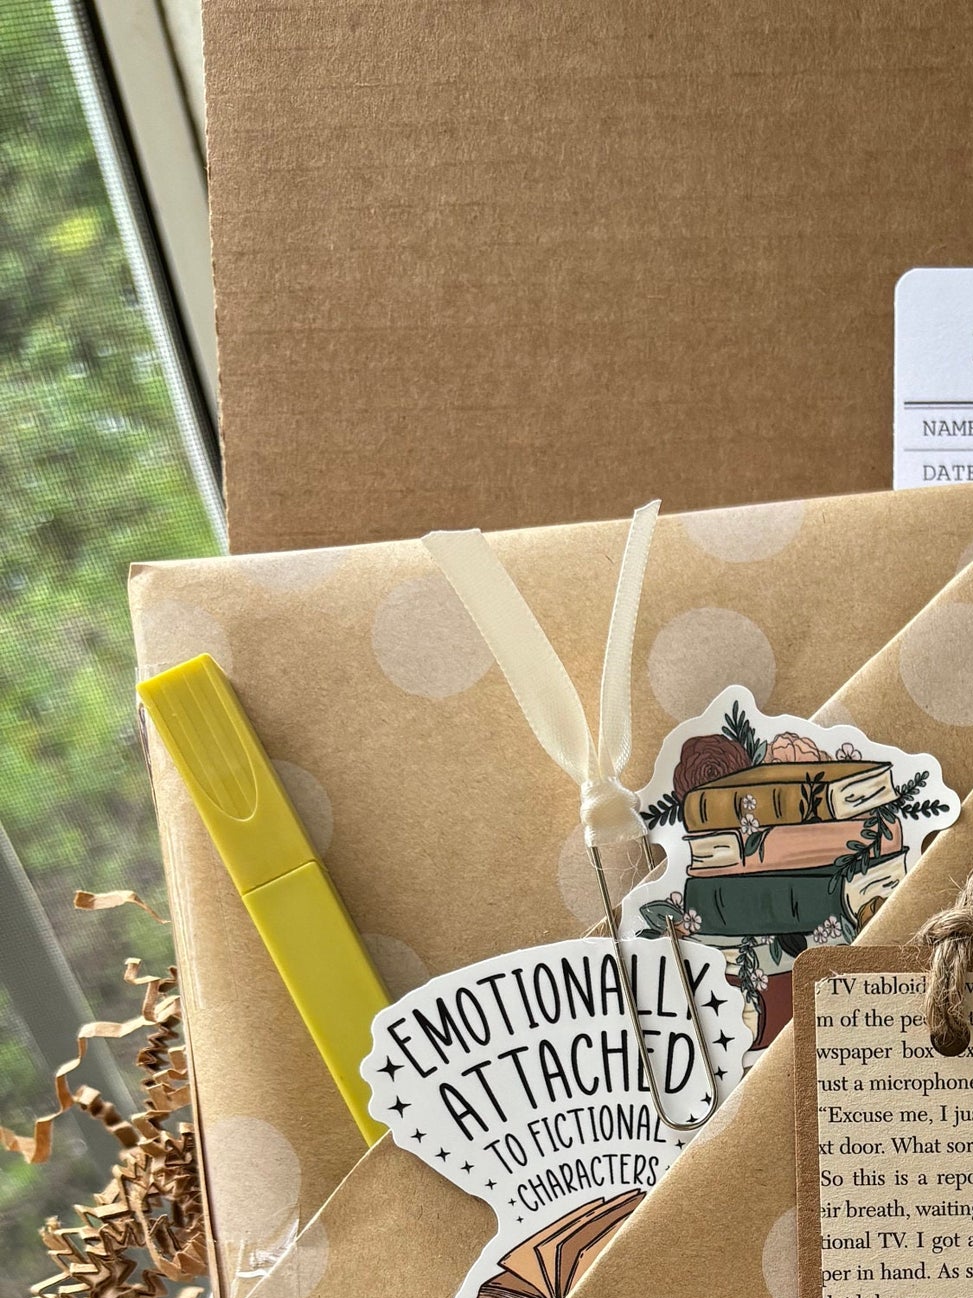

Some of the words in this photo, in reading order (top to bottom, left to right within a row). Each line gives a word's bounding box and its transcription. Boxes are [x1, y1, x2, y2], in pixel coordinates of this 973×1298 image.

[828, 977, 856, 995] TV
[387, 953, 710, 1079] EMOTIONALLY
[840, 1010, 860, 1028] of
[865, 1010, 894, 1027] the
[902, 1041, 934, 1059] box
[439, 1029, 695, 1141] ATTACHED
[854, 1079, 864, 1091] a
[819, 1105, 893, 1124] “Excuse
[901, 1110, 932, 1126] me,
[940, 1104, 948, 1122] I
[483, 1137, 528, 1176] TO
[528, 1104, 666, 1158] FICTIONAL
[840, 1137, 884, 1155] door.
[892, 1136, 940, 1154] What
[517, 1153, 659, 1213] CHARACTERS
[821, 1170, 843, 1187] So
[853, 1169, 885, 1187] this
[895, 1170, 908, 1186] is
[918, 1174, 927, 1186] a
[846, 1200, 910, 1221] breath,
[878, 1231, 908, 1249] TV.
[932, 1233, 960, 1253] got
[857, 1264, 874, 1280] in
[880, 1262, 930, 1280] hand.
[938, 1261, 959, 1279] As
